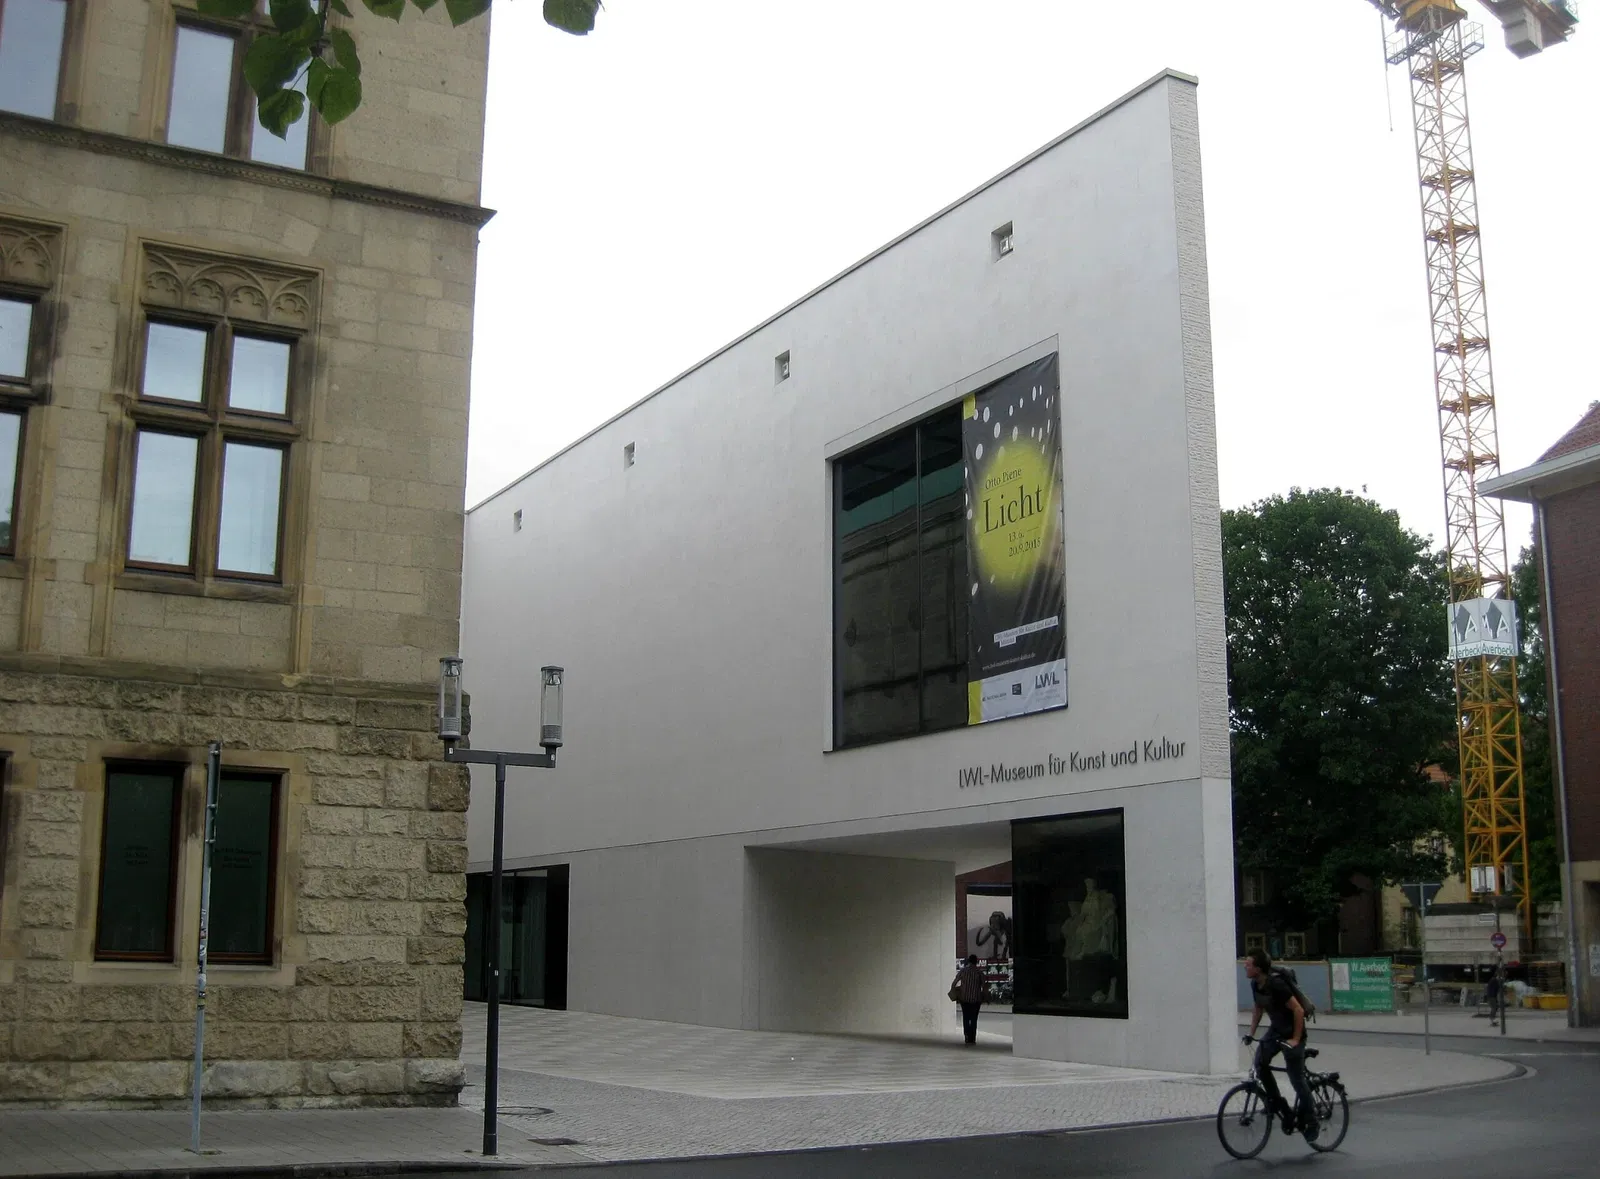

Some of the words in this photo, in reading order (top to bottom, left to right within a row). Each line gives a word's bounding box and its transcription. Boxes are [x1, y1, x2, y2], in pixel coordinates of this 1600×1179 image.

[985, 477, 1001, 490] Otto
[1002, 468, 1022, 482] Piene
[983, 483, 1044, 534] Licht
[1008, 531, 1025, 543] 13.6.
[1008, 537, 1042, 558] 20.9.2015
[1449, 645, 1481, 659] Aerbeck
[1482, 643, 1515, 655] Averbeck
[1035, 672, 1060, 689] LWL
[959, 762, 1045, 789] LWL-Museum
[1049, 752, 1067, 776] für
[1070, 750, 1106, 773] Kunst
[1110, 740, 1138, 767] und
[1143, 736, 1186, 762] Kultur
